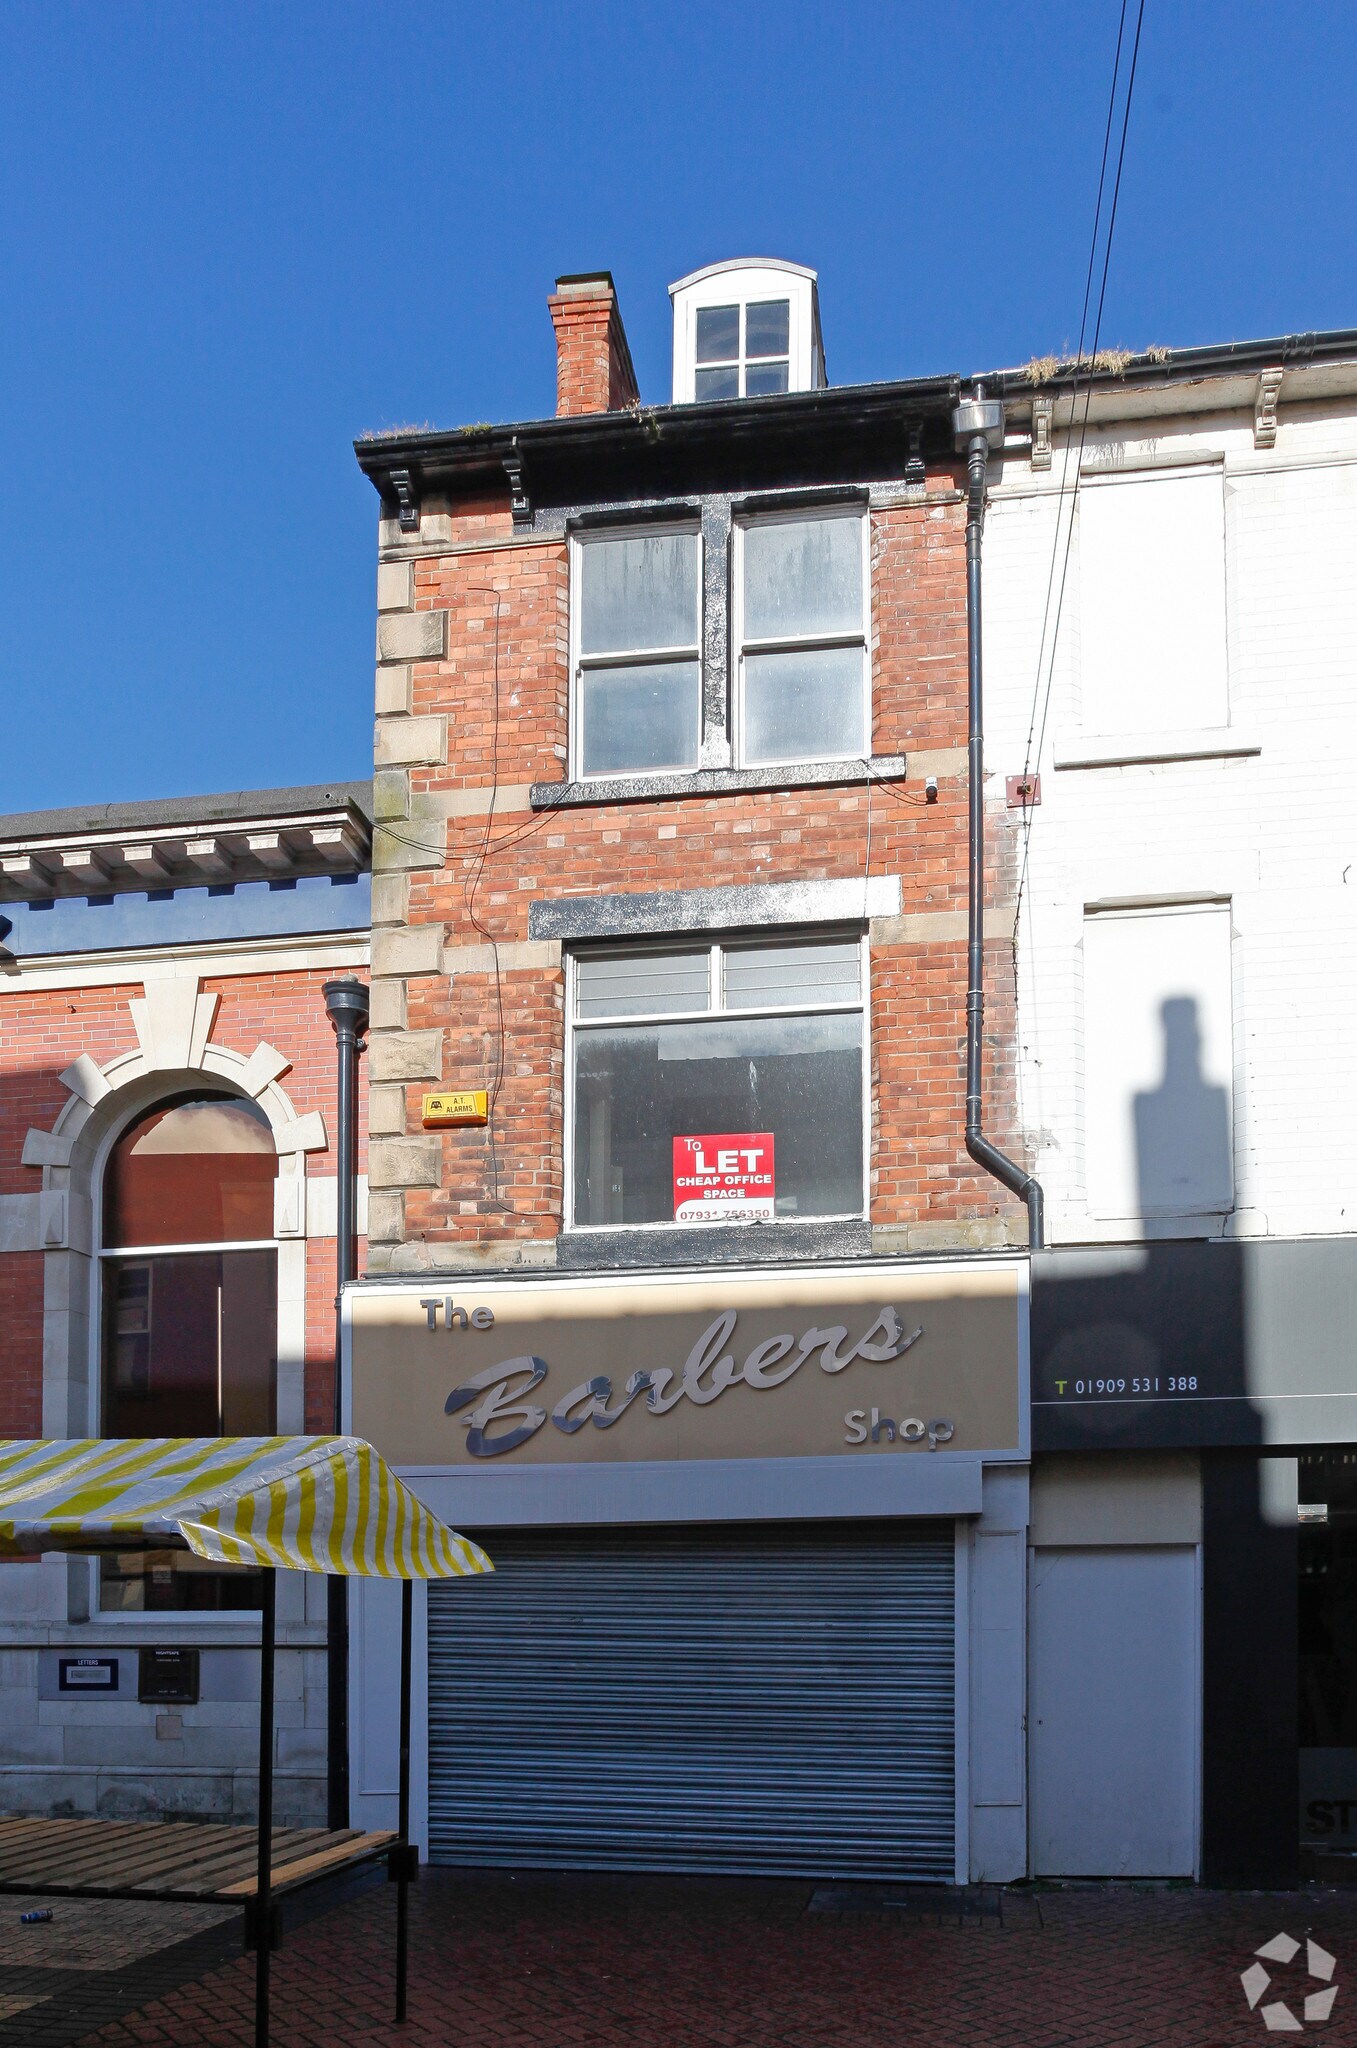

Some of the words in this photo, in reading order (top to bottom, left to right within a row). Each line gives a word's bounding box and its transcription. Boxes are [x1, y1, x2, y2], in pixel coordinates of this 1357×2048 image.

[446, 1105, 473, 1113] ALARMS
[684, 1138, 702, 1151] To
[695, 1149, 764, 1174] LET
[677, 1176, 720, 1186] CHEAP
[724, 1175, 771, 1184] OFFICE
[703, 1189, 745, 1198] SPACE
[723, 1209, 770, 1219] 756350
[420, 1297, 495, 1331] The
[444, 1305, 926, 1457] Barbers
[1054, 1380, 1068, 1394] T
[1075, 1378, 1126, 1394] 01909
[1131, 1377, 1159, 1392] 531
[1167, 1376, 1198, 1391] 388
[844, 1408, 955, 1451] Shop
